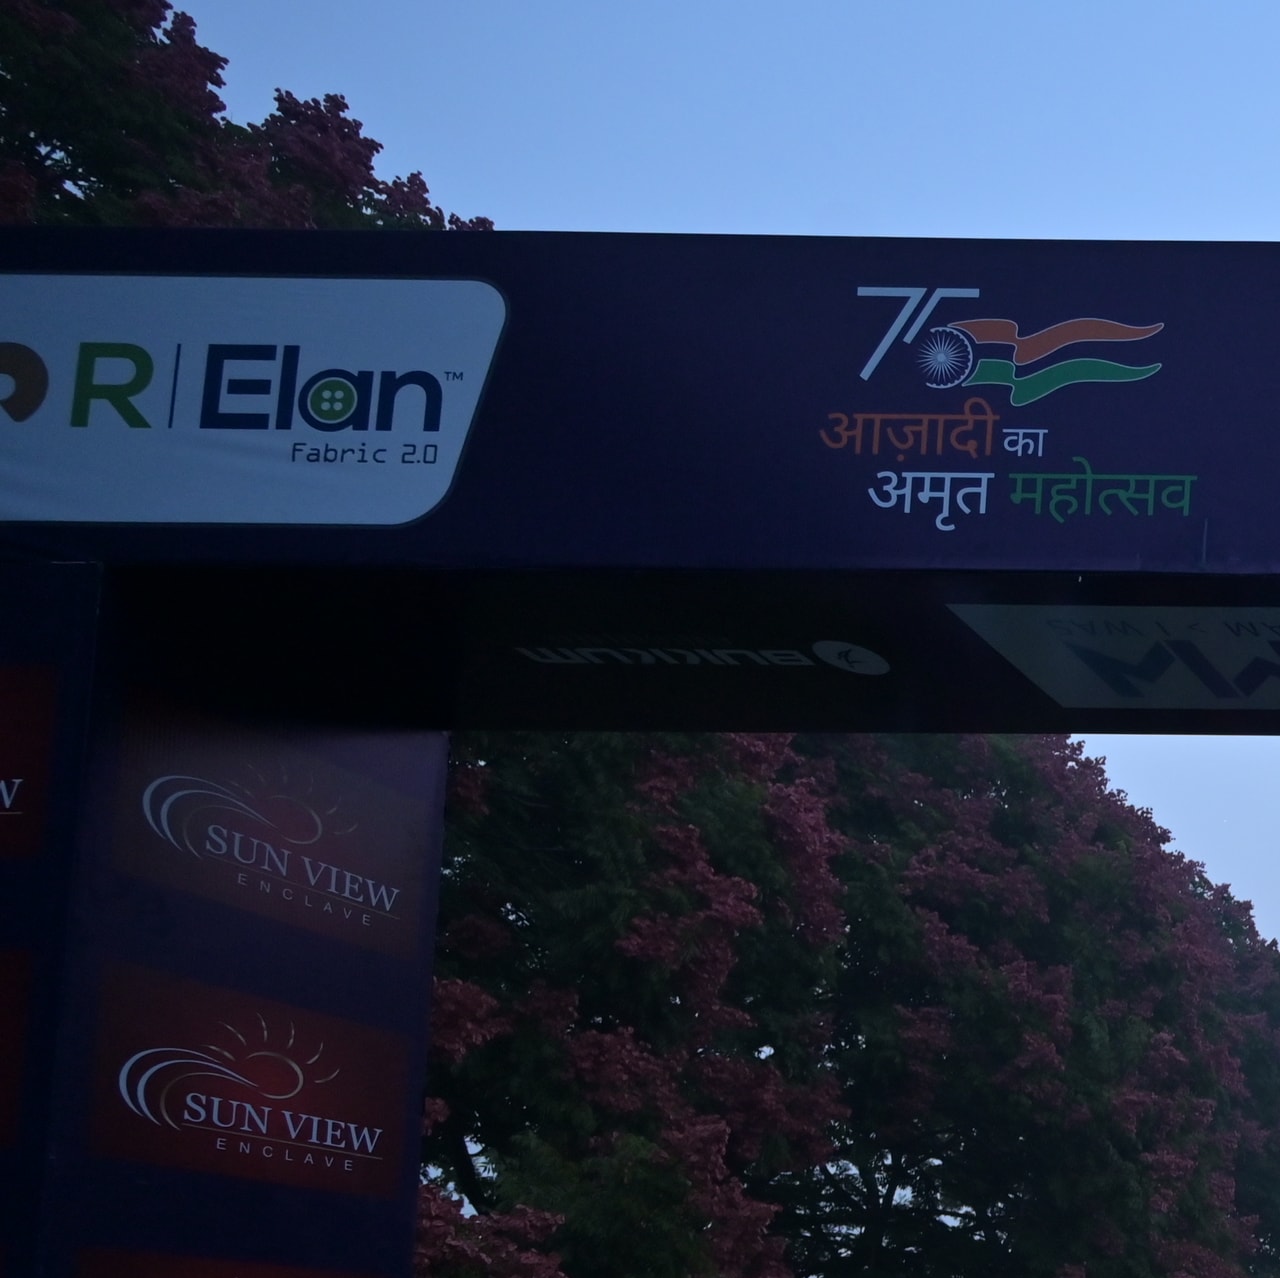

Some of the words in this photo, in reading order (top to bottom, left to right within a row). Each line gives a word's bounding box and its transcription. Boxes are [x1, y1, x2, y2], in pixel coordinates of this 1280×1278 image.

[70, 342, 153, 428] R
[200, 345, 442, 432] Elan
[292, 443, 386, 463] Fabric
[402, 445, 437, 463] 2.0
[819, 398, 999, 461] आज़ादी
[1002, 428, 1048, 457] का
[868, 470, 994, 531] अमृत
[1008, 457, 1197, 524] महोत्सव
[1046, 620, 1145, 637] WAS
[205, 824, 292, 877] SUN
[301, 856, 400, 912] VIEW
[238, 873, 371, 925] ENCLAVE
[183, 1092, 271, 1134] SUN
[281, 1111, 382, 1153] VIEW
[217, 1138, 353, 1171] ENCLAVE
